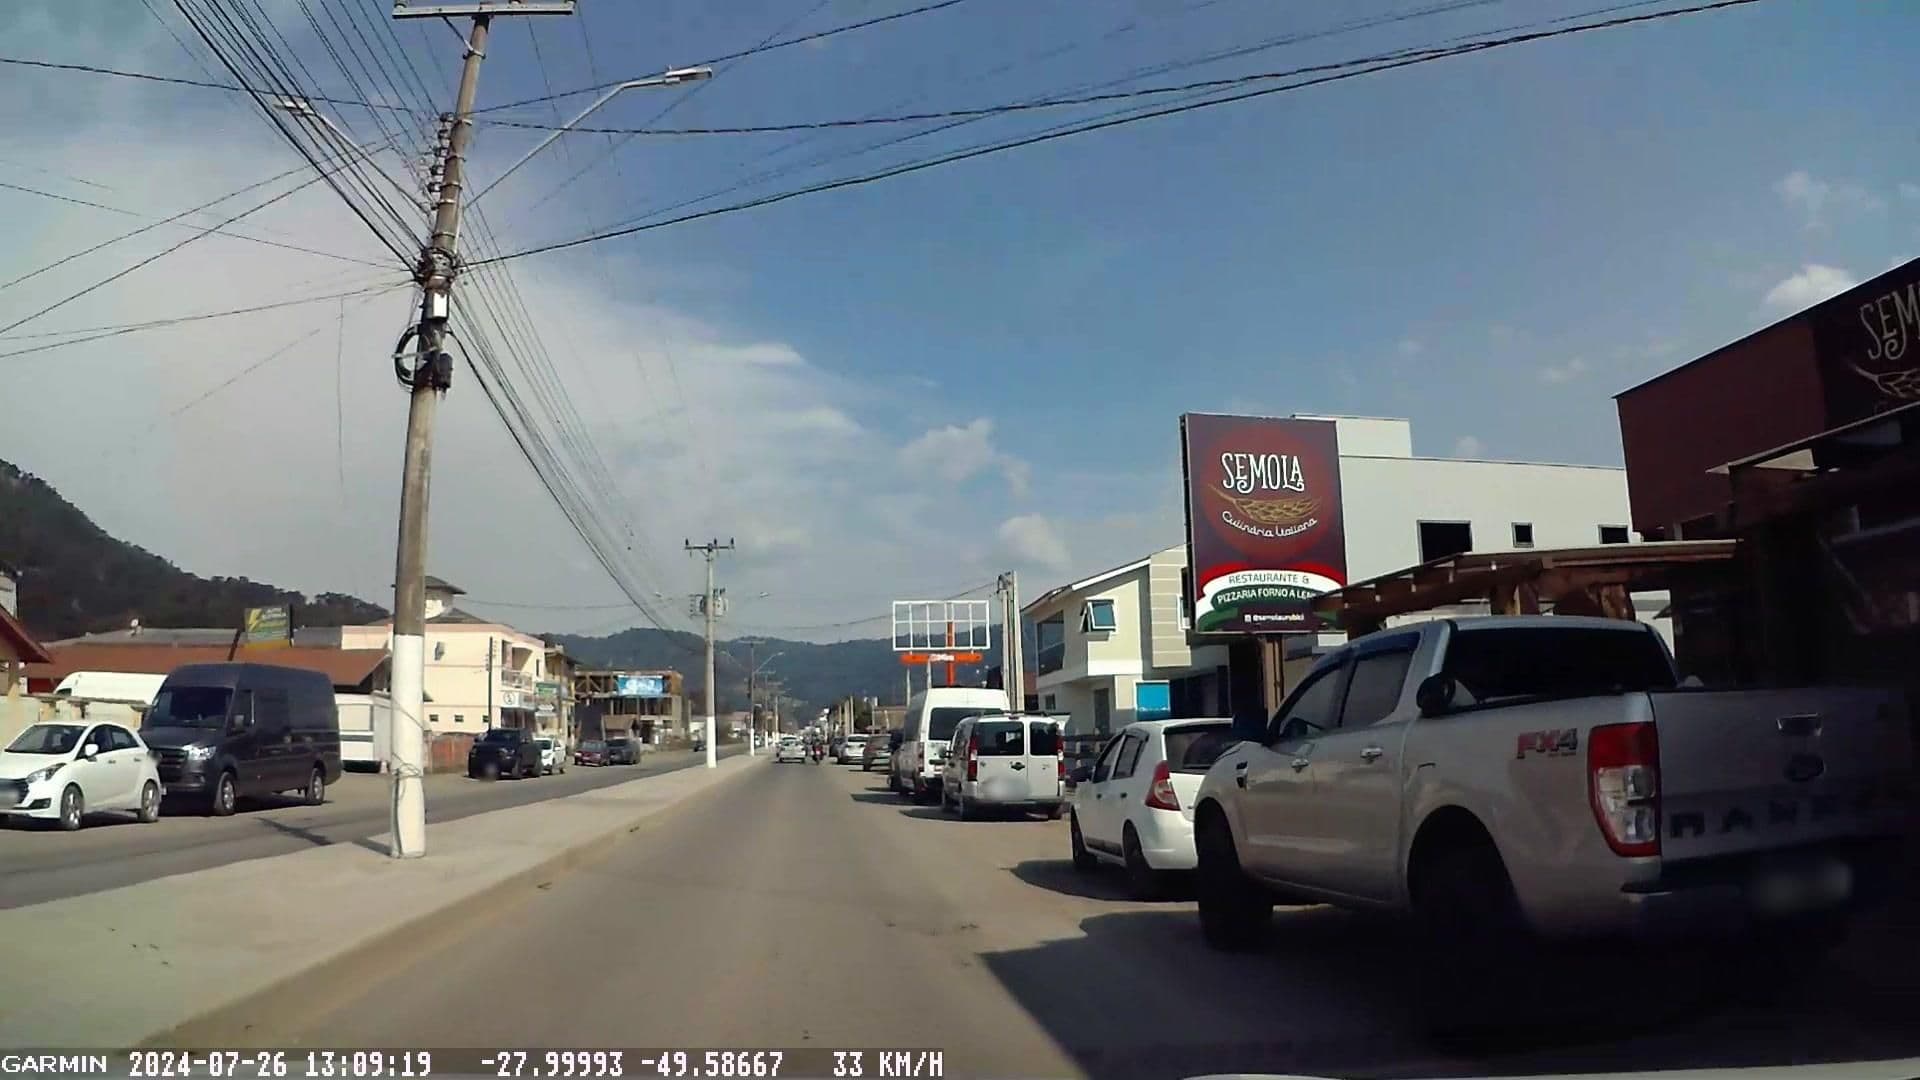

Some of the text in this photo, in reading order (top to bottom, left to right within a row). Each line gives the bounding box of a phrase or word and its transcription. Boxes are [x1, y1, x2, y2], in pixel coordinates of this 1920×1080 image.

[1221, 453, 1305, 494] SEMOLA
[1229, 572, 1310, 585] RESTAURANTE &
[1217, 589, 1257, 605] PIZZARIA
[1258, 587, 1288, 598] FORNO
[1289, 589, 1297, 598] A
[1516, 727, 1577, 759] FX4
